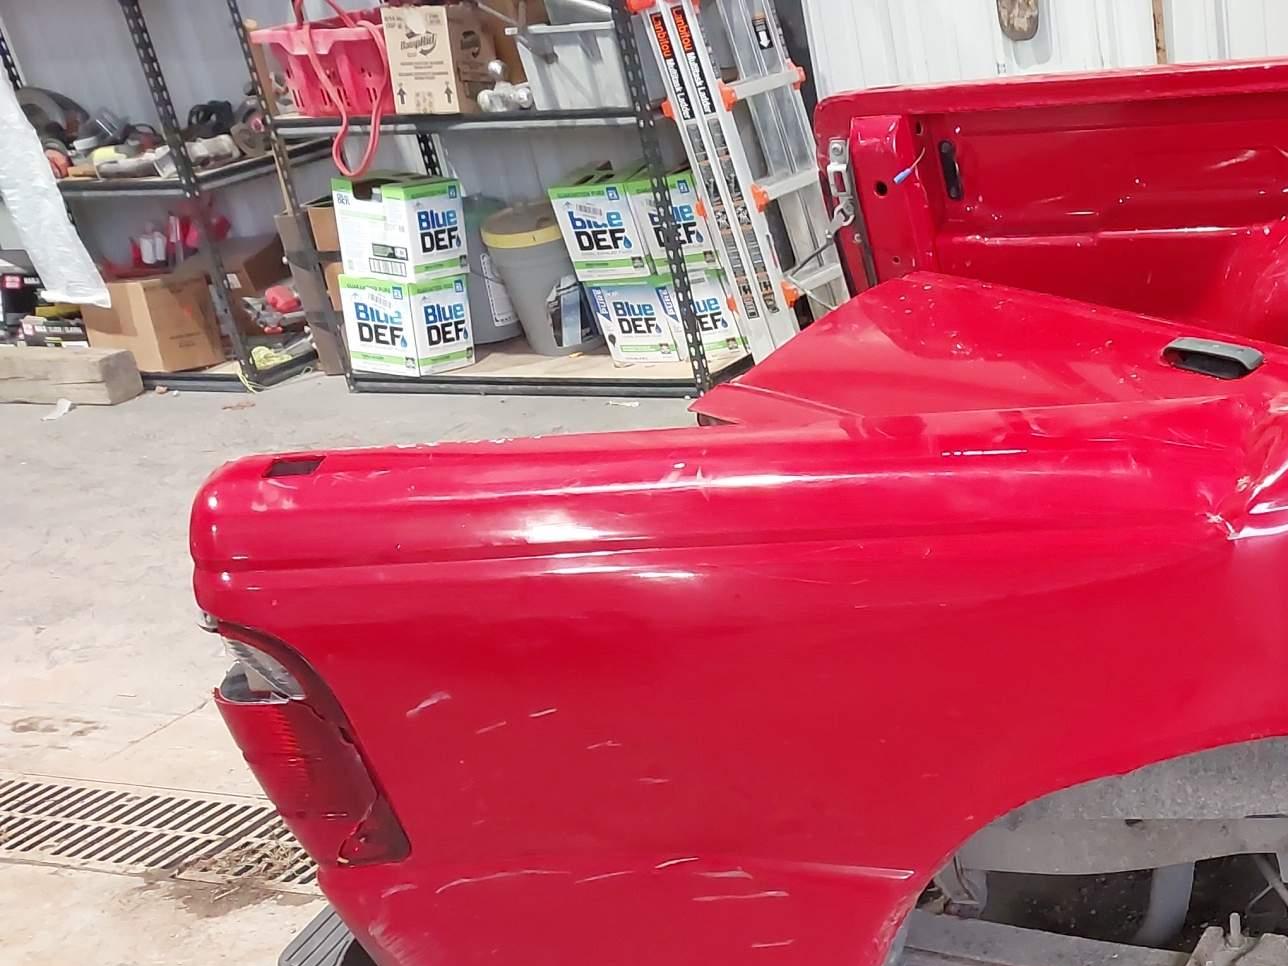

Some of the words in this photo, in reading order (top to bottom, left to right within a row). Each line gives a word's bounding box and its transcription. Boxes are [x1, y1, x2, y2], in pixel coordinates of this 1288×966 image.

[676, 92, 691, 119] Ladder
[697, 86, 712, 114] Ladder
[417, 209, 458, 231] Blue
[420, 226, 458, 254] DEF
[574, 228, 626, 251] DEF
[423, 303, 465, 325] Blue
[612, 301, 655, 317] Blue
[357, 322, 404, 346] DEF
[426, 319, 466, 346] DEF
[618, 317, 657, 335] DEF
